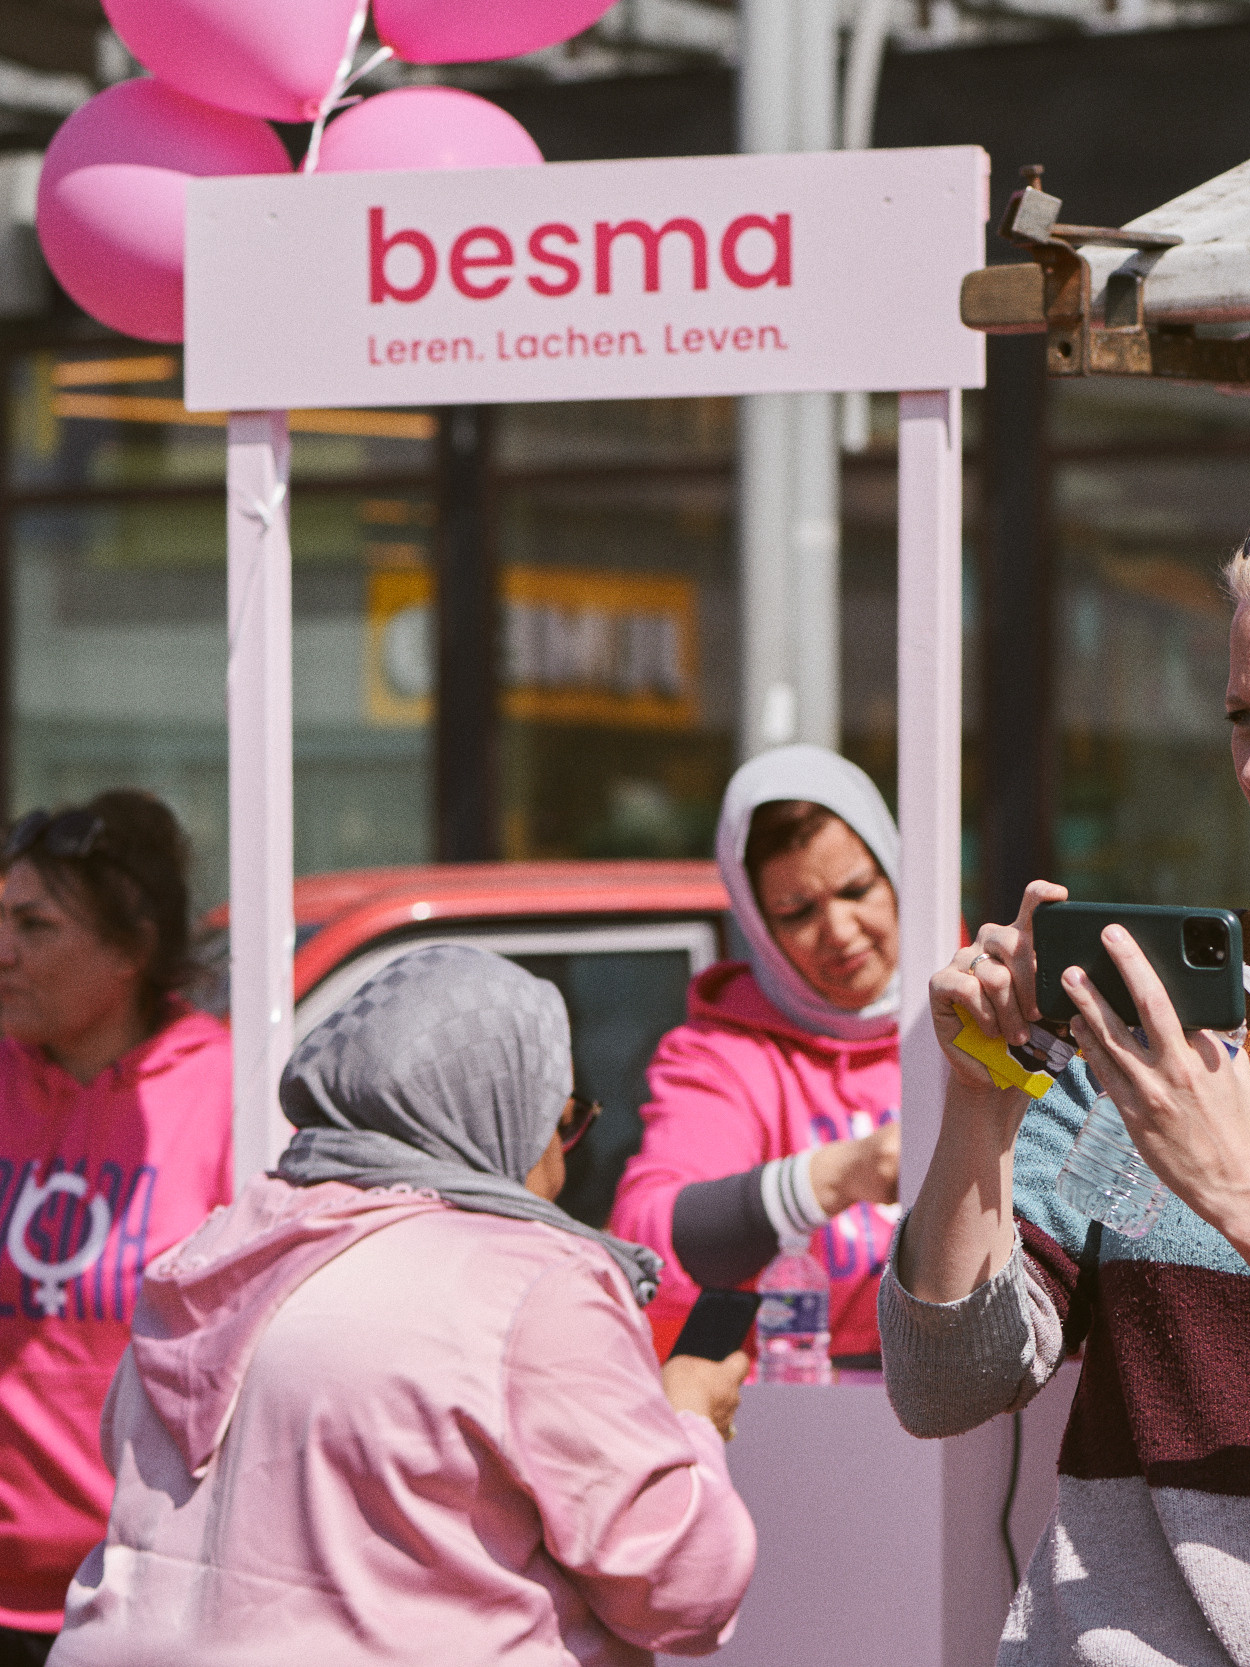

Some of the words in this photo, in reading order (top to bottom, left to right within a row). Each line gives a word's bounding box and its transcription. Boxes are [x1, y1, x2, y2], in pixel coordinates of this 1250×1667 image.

[367, 206, 794, 306] besma
[368, 335, 485, 366] Leren.
[497, 327, 646, 361] Lachen.
[664, 323, 788, 355] Leven.
